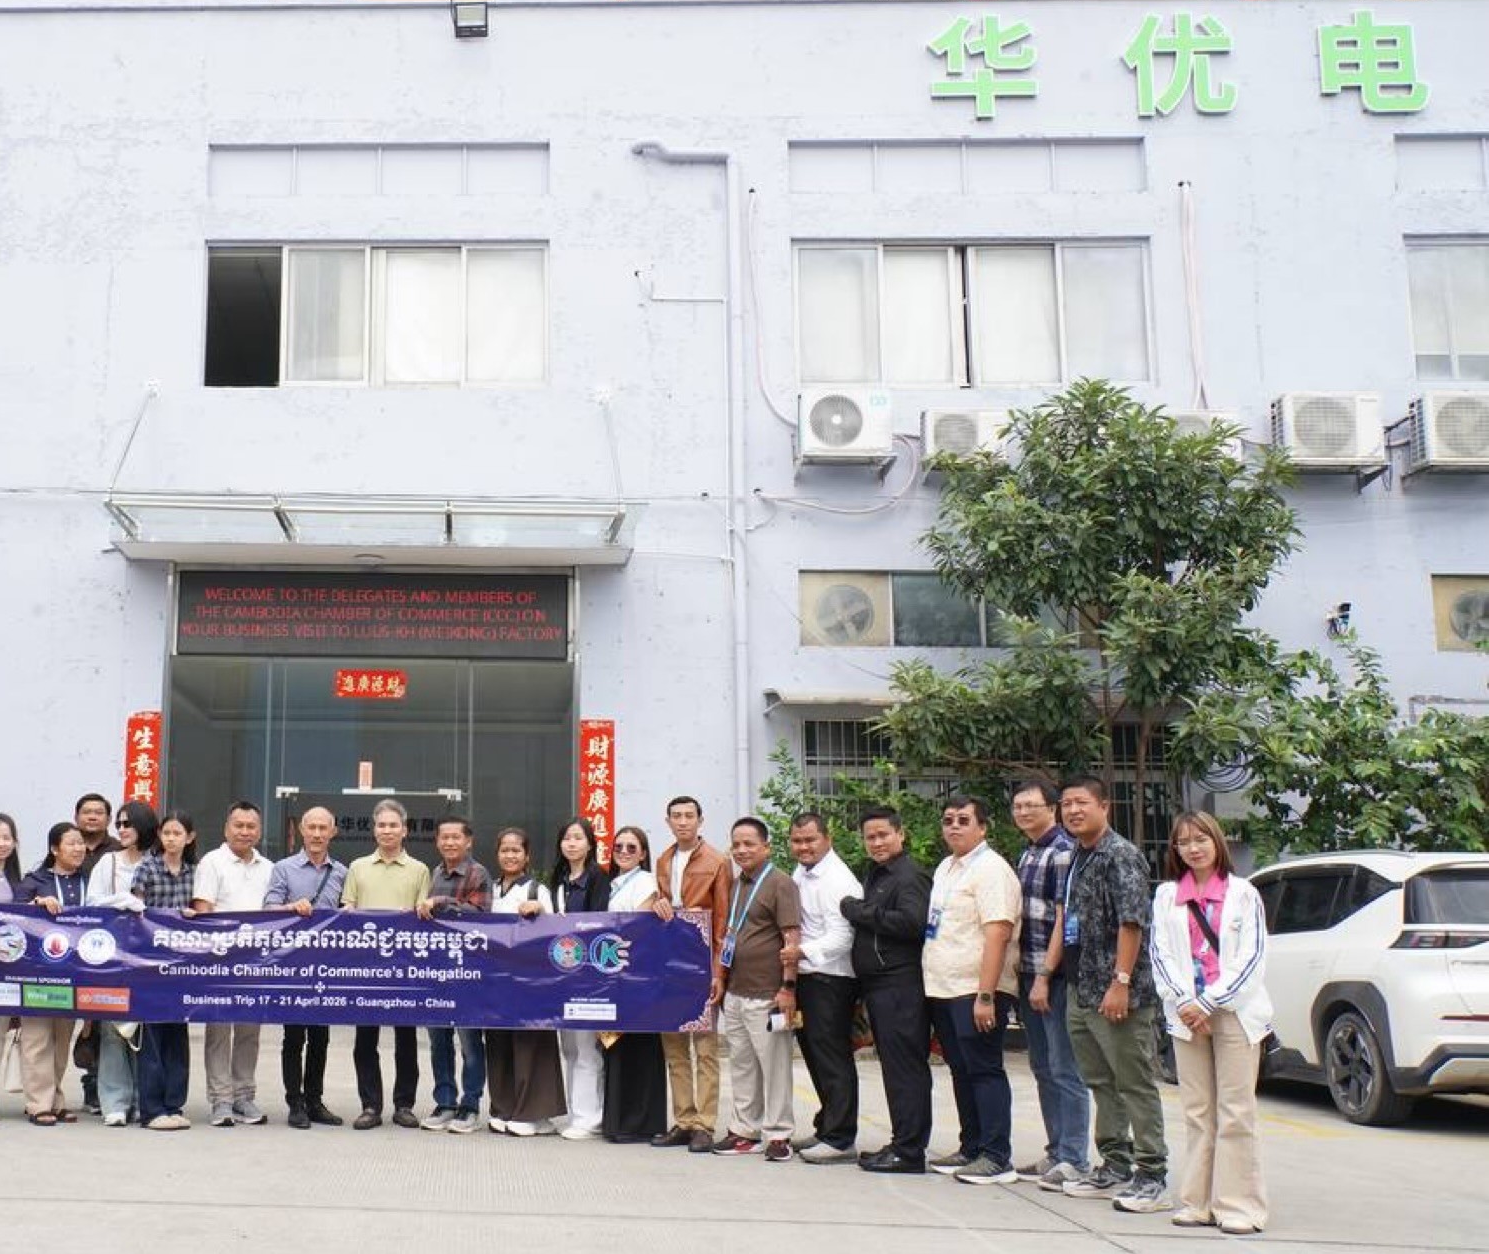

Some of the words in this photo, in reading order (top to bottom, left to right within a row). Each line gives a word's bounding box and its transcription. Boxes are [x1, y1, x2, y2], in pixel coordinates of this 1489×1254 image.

[927, 9, 1431, 120] 华优电
[205, 587, 275, 601] WELCOME
[281, 588, 297, 601] TO
[300, 589, 326, 601] THE
[331, 589, 407, 603] DELEGATES
[411, 591, 441, 603] AND
[445, 592, 512, 603] MEMBERS
[516, 592, 537, 604] OF
[196, 606, 222, 619] THE
[224, 606, 301, 620] CAMBODIA
[303, 607, 371, 620] CHAMBER
[376, 608, 393, 620] OF
[398, 609, 479, 622] COMMERCE
[181, 622, 222, 636] YOUR
[223, 623, 289, 636] BUSINESS
[294, 624, 327, 638] VISIT
[331, 624, 350, 637] TO
[499, 627, 563, 640] FACTORY
[158, 963, 230, 976] Cambodia
[233, 963, 295, 977] Chamber
[300, 965, 314, 977] of
[317, 964, 403, 979] Commerce's
[407, 966, 481, 982] Delegation
[182, 995, 232, 1005] Business
[234, 995, 256, 1007] Trip
[258, 996, 270, 1005] 17
[279, 996, 292, 1006] 21
[294, 996, 320, 1007] April
[355, 997, 416, 1009] Guangzhou
[425, 998, 456, 1008] China
